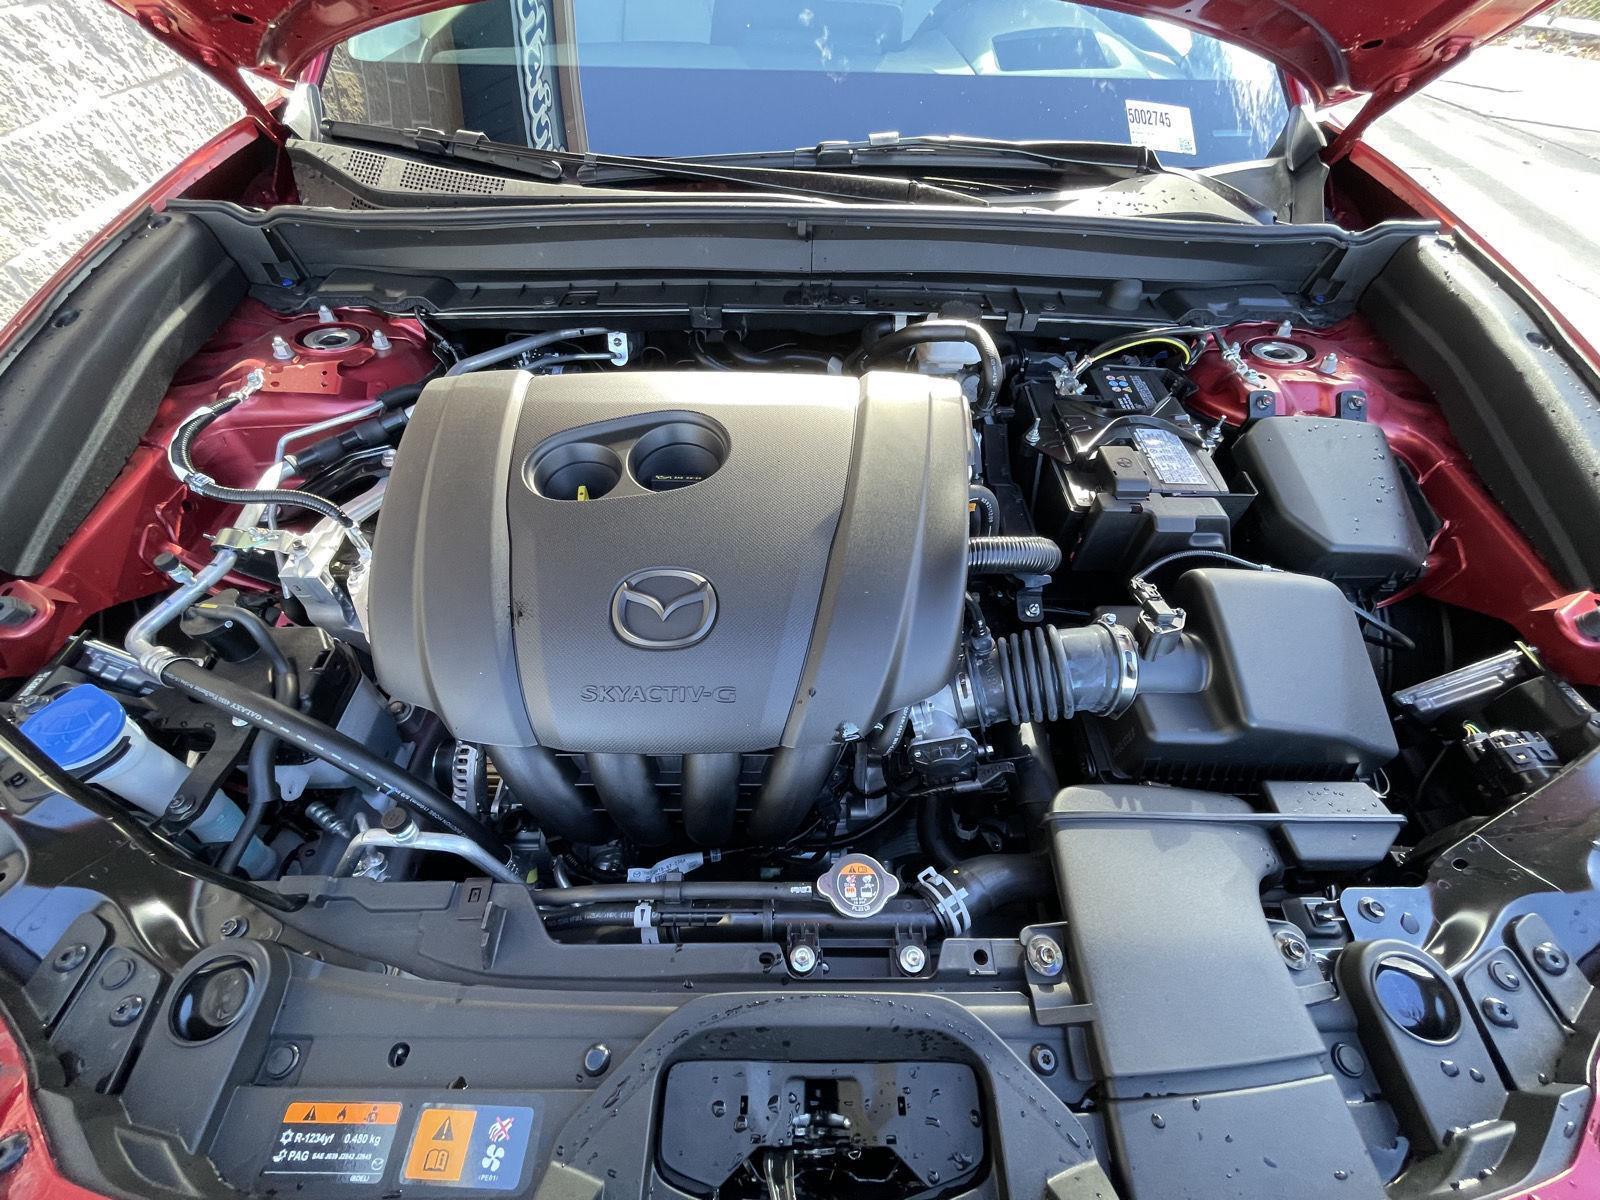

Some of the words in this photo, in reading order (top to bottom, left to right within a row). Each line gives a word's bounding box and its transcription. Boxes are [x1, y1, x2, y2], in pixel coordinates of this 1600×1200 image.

[1128, 108, 1171, 128] 5002745
[580, 684, 737, 704] SKYACTIV-G
[230, 703, 262, 720] GALAXY
[368, 1134, 382, 1146] kg
[287, 1150, 310, 1162] PAG
